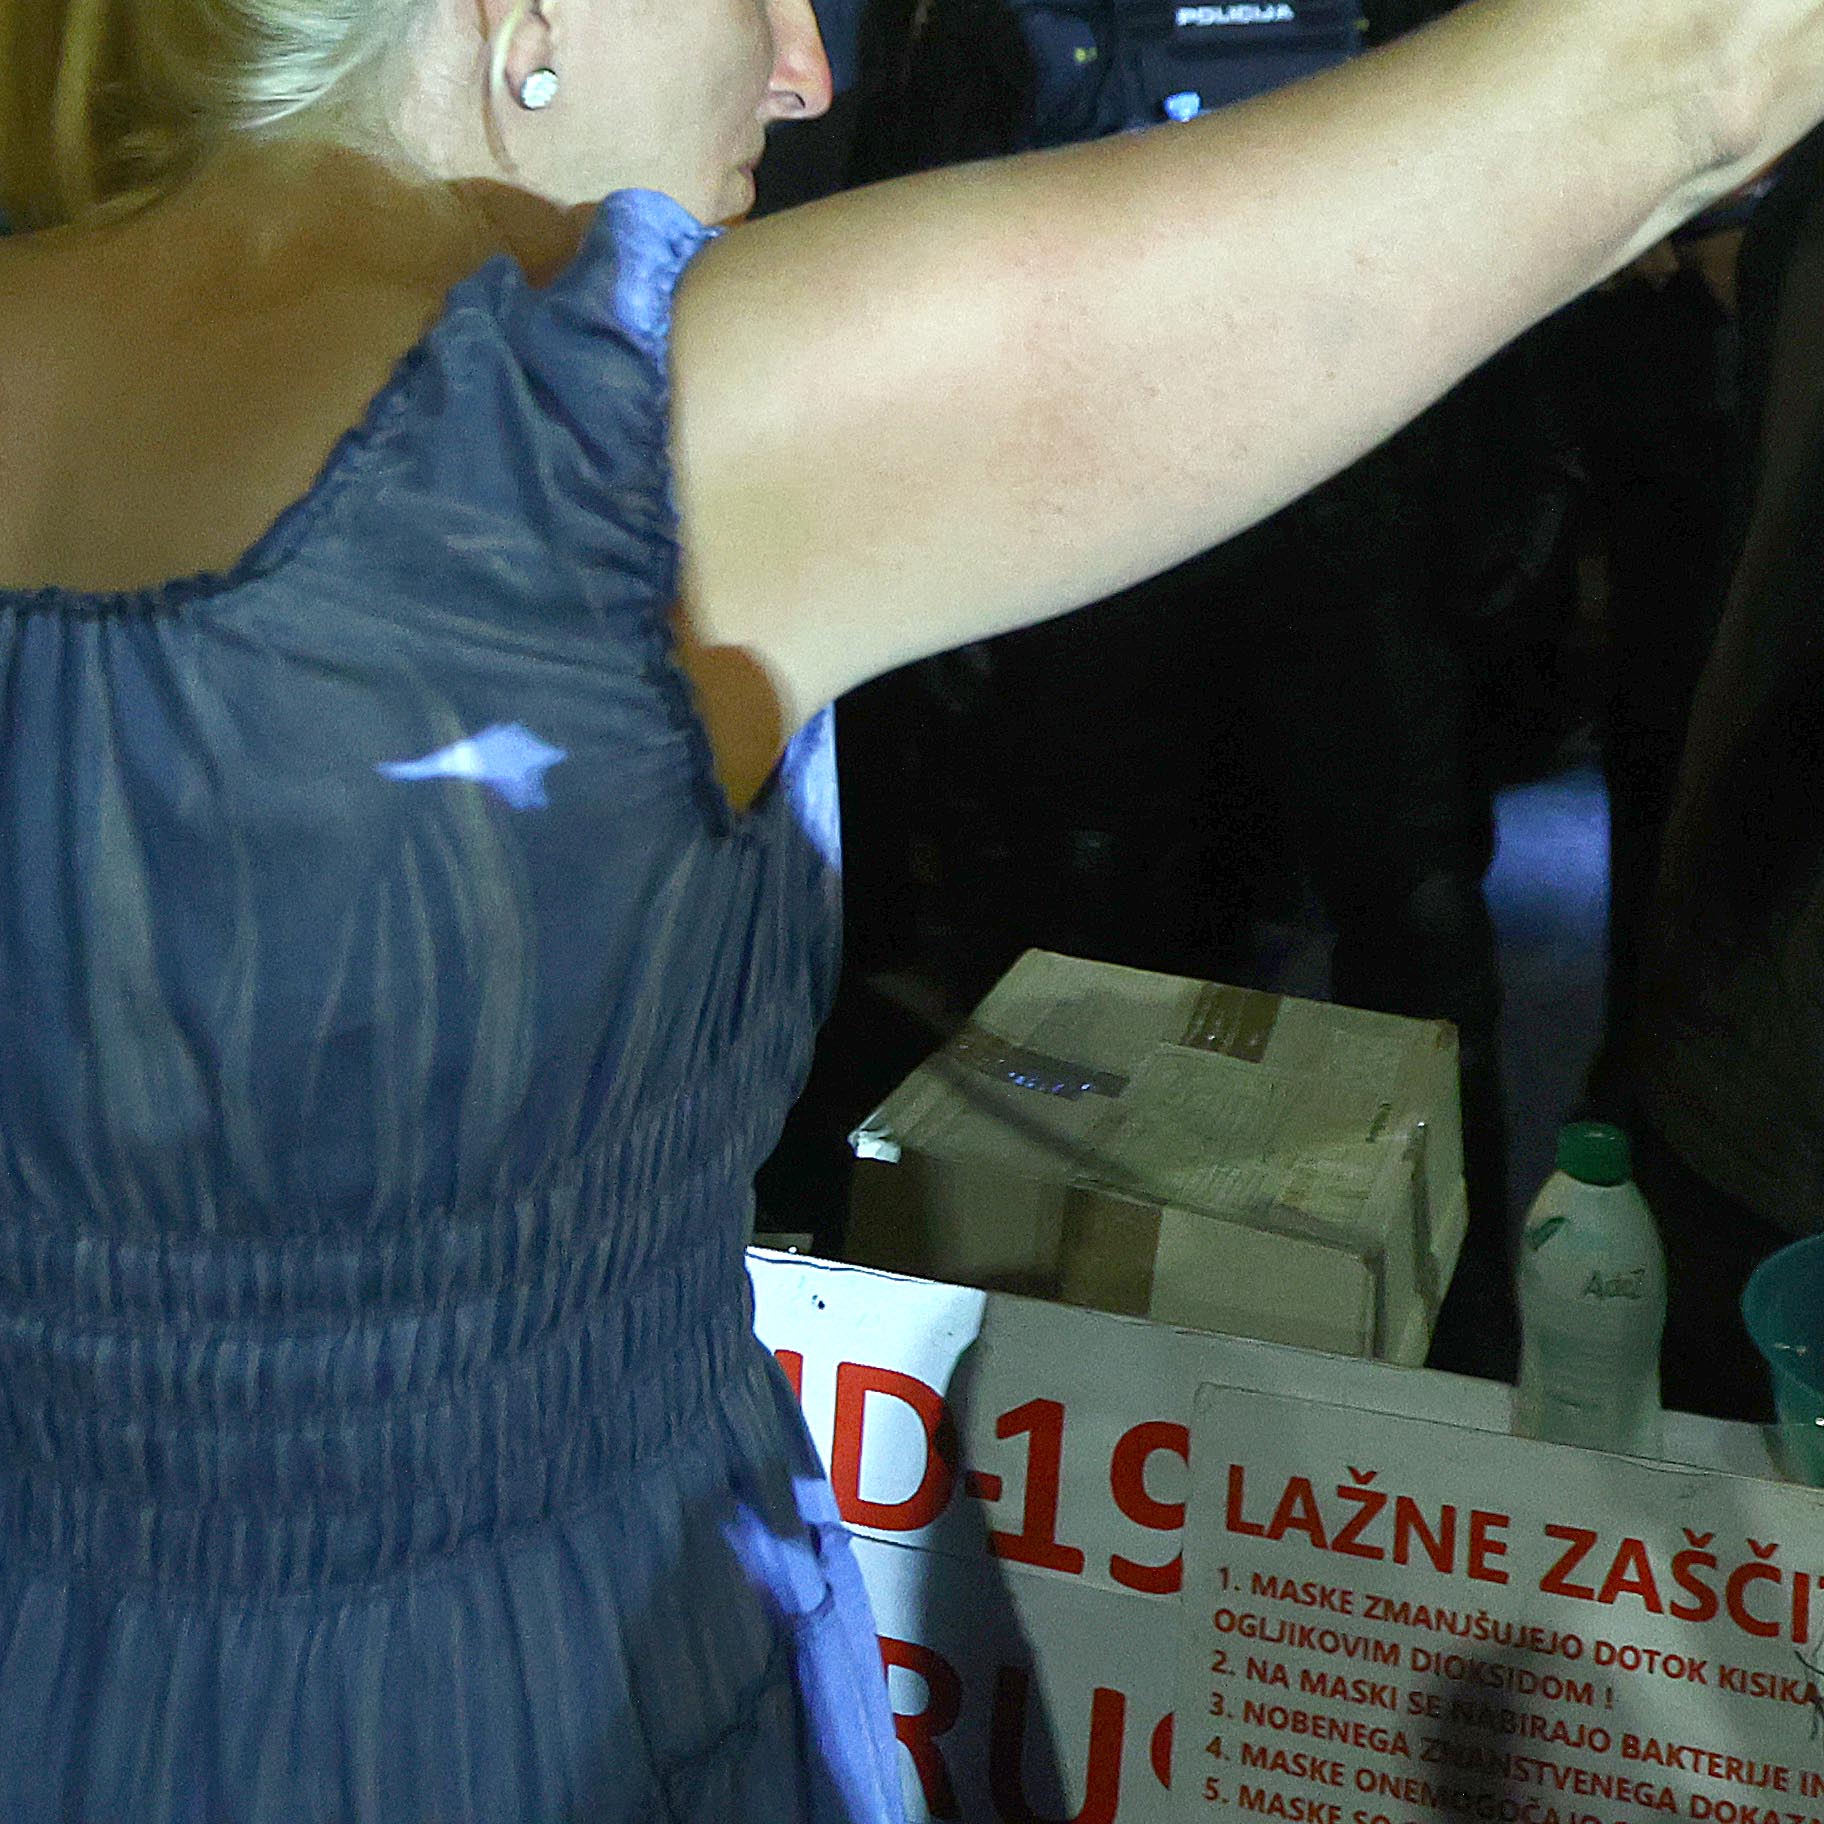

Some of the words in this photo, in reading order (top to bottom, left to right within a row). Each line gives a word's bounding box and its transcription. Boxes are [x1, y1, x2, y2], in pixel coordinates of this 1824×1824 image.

[1175, 2, 1294, 26] POLICIJA
[1225, 1464, 1510, 1585] LAŽNE
[1212, 1608, 1401, 1667] OGLJIKOVIM
[1409, 1647, 1594, 1707] DIOKSIDOM
[1218, 1566, 1241, 1592] 1.
[1250, 1572, 1353, 1616] MASKE
[1363, 1592, 1584, 1662] ZMANJŠUJEJO
[1593, 1640, 1709, 1686] DOTOK
[1718, 1663, 1821, 1706] KISIKA
[877, 1635, 1176, 1824] RU
[1205, 1736, 1229, 1762] 4.
[1241, 1742, 1345, 1787] MASKE
[1208, 1692, 1233, 1720] 3.
[1242, 1699, 1411, 1760] NOBENEGA
[1690, 1794, 1822, 1824] DOKA
[1211, 1650, 1235, 1677] 2.
[1246, 1657, 1290, 1689] NA
[1299, 1669, 1398, 1712] MASKI
[1407, 1691, 1441, 1719] SE
[1451, 1699, 1611, 1754] NABIRAJO
[1621, 1733, 1790, 1794] BAKTERIJE
[1203, 1776, 1228, 1805] 5.
[1238, 1784, 1342, 1824] MASKE
